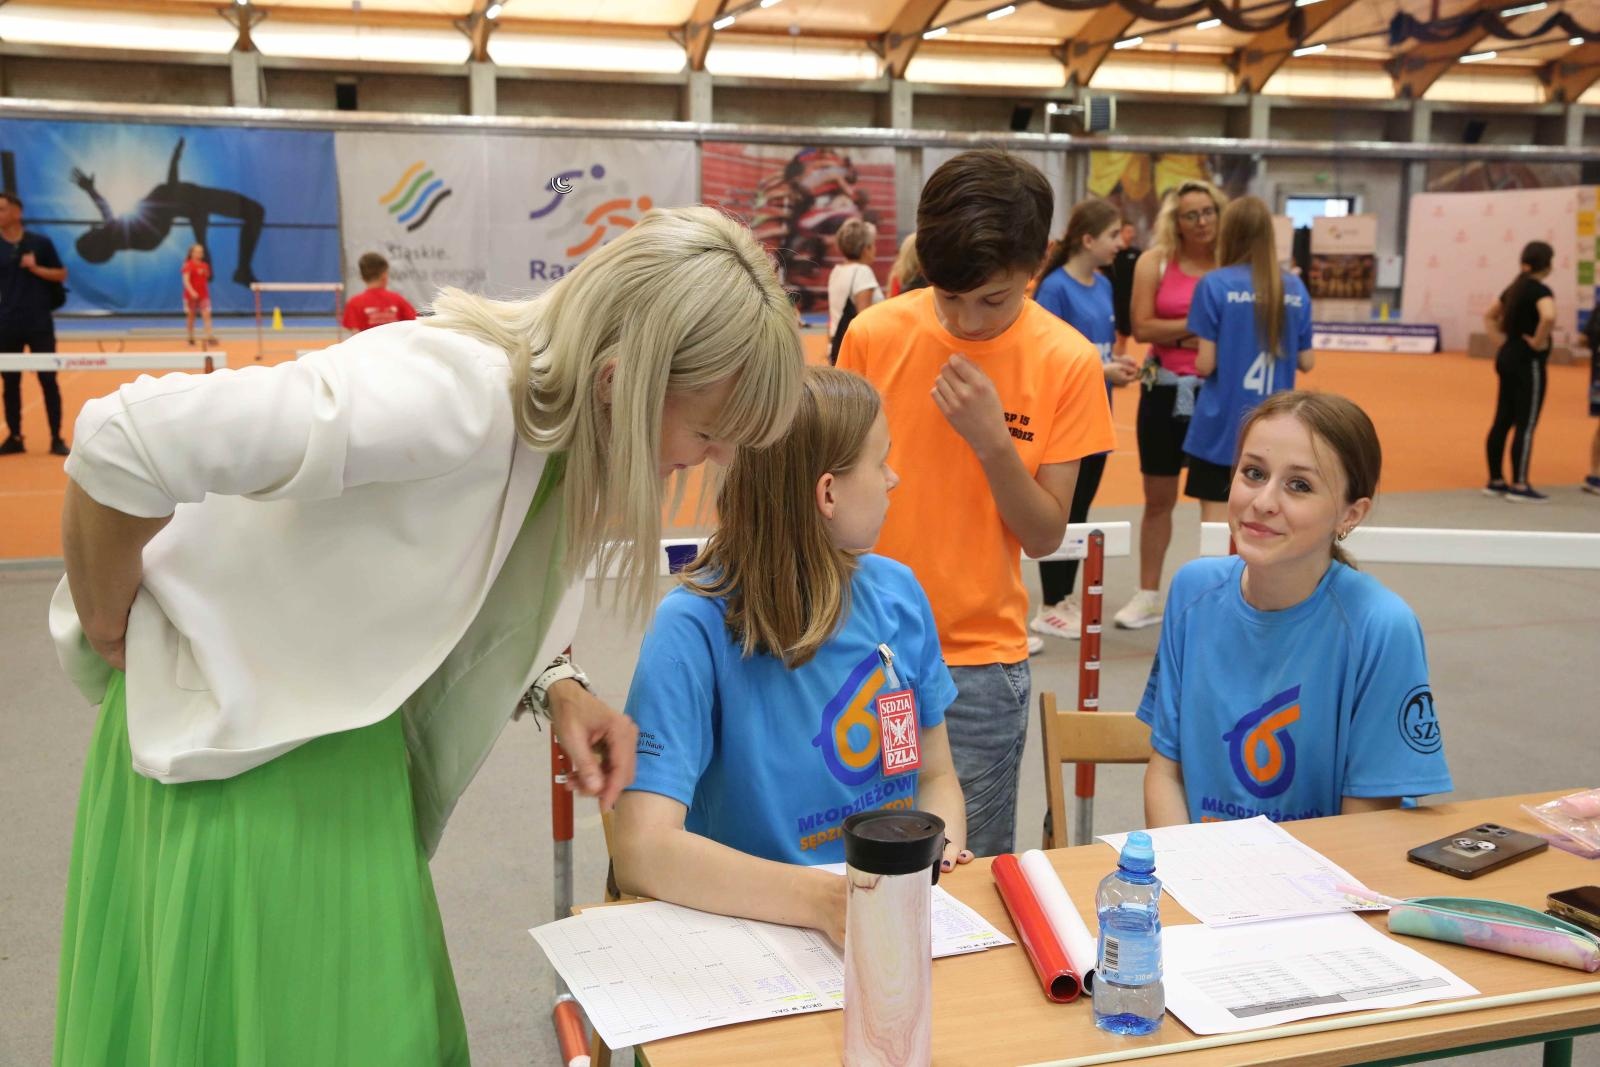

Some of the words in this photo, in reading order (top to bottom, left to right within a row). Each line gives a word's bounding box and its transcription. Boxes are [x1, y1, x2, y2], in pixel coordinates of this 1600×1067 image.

[1243, 351, 1276, 396] 41
[1019, 415, 1031, 426] 15
[887, 748, 917, 766] PZLA
[797, 775, 912, 833] MŁODZIEŻOW
[800, 827, 843, 851] SĘDZI
